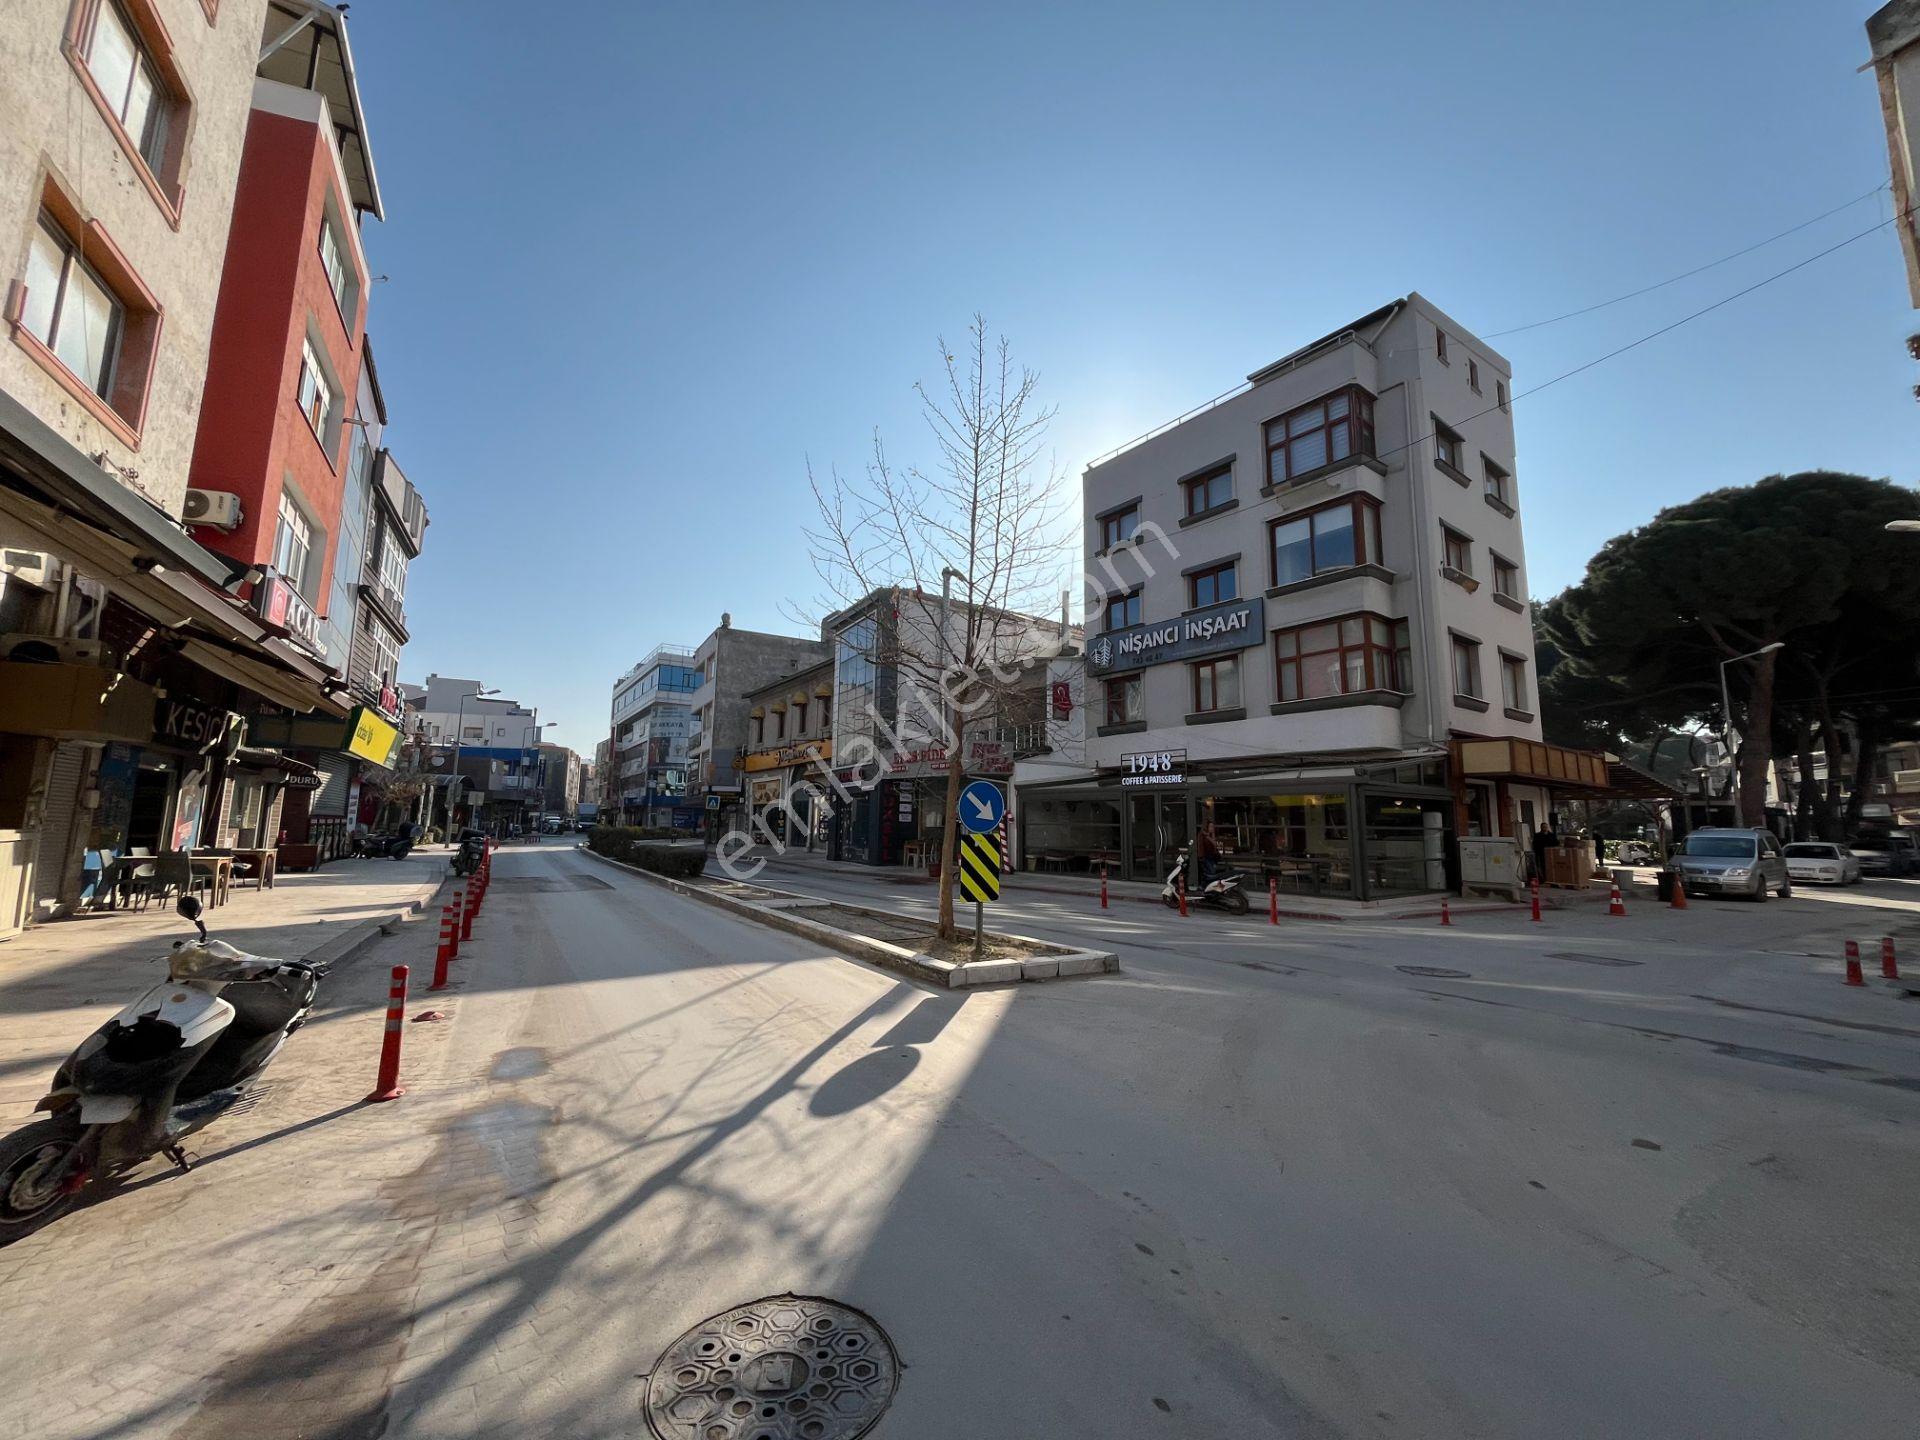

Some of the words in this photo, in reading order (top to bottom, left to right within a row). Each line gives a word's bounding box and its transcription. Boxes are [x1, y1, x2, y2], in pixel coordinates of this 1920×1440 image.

[287, 595, 320, 643] ACAR
[1119, 626, 1178, 654] NİŞANCI
[1185, 610, 1250, 640] İNŞAAT
[1130, 752, 1171, 773] 1948
[290, 775, 318, 785] DURU
[1122, 776, 1143, 785] COFFEE
[1149, 774, 1182, 783] PATISSERIE
